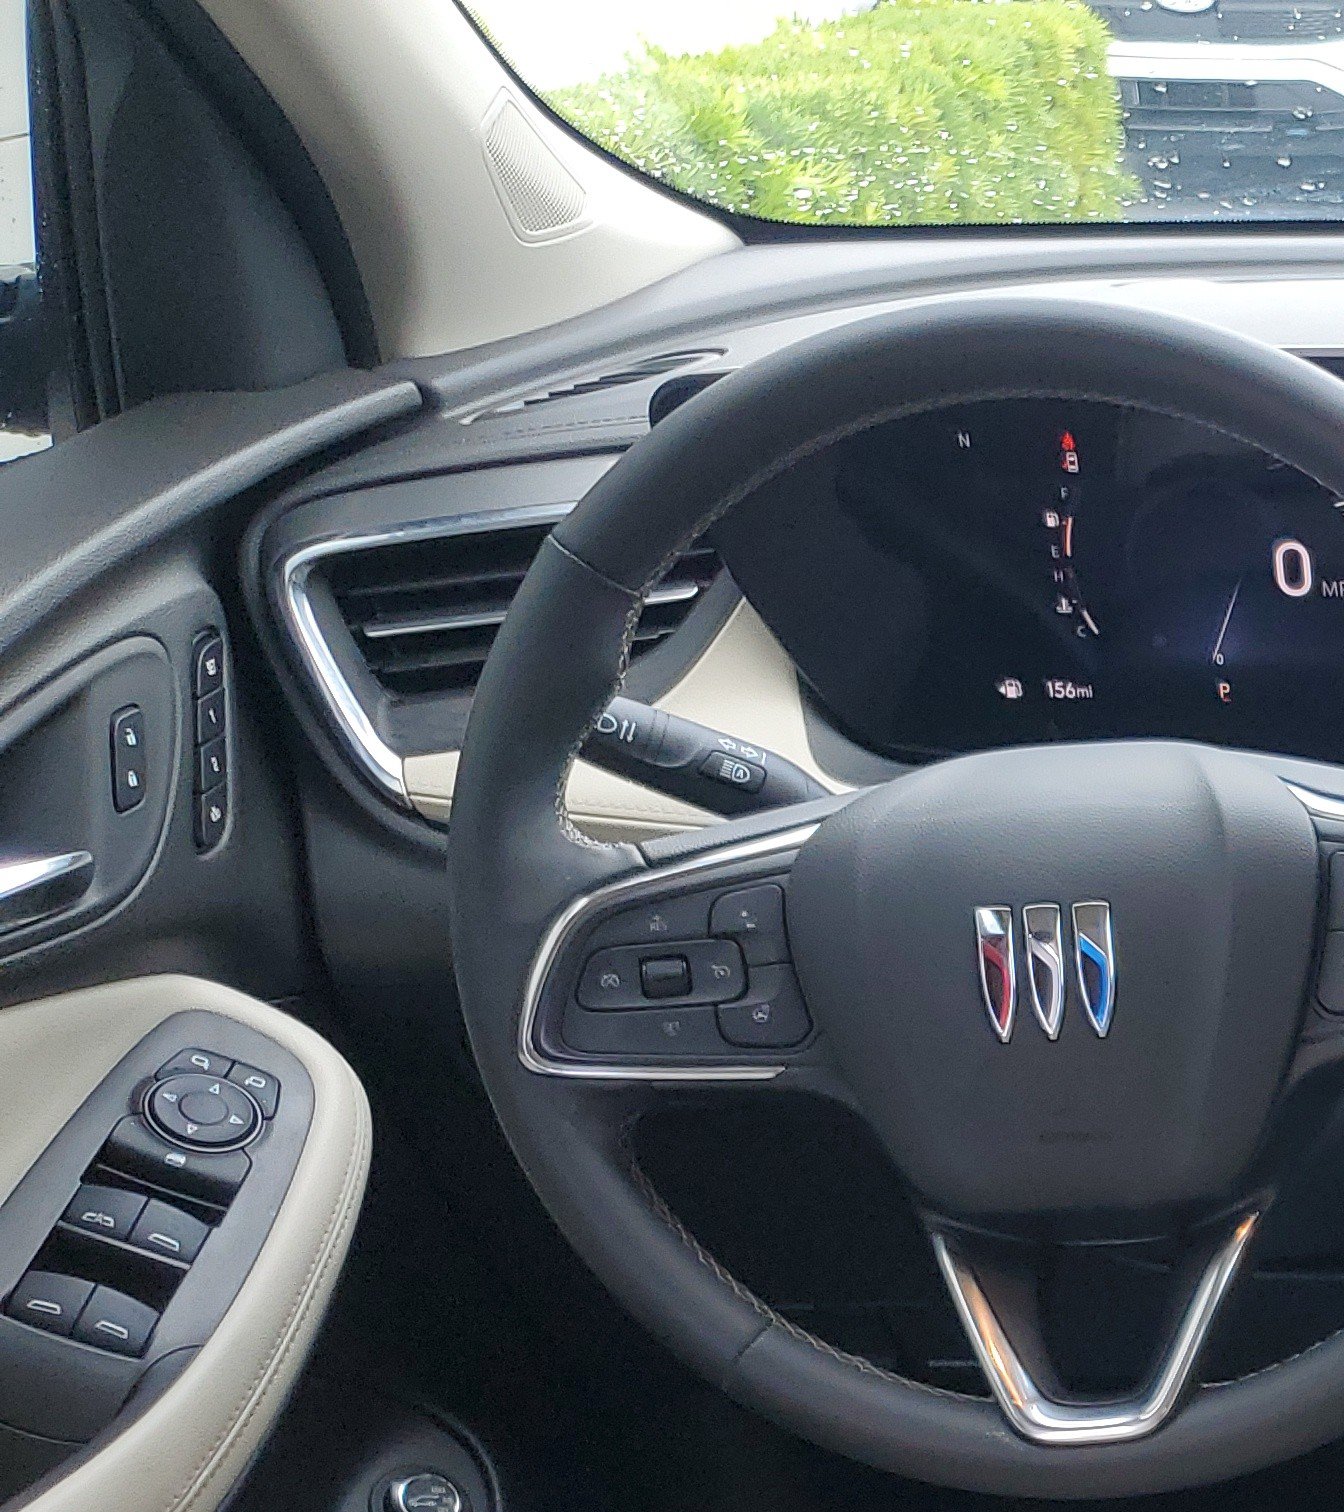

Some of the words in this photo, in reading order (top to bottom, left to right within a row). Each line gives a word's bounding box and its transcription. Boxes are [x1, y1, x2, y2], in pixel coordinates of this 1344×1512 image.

[957, 431, 971, 449] N
[1275, 541, 1312, 597] 0
[1219, 682, 1230, 699] P
